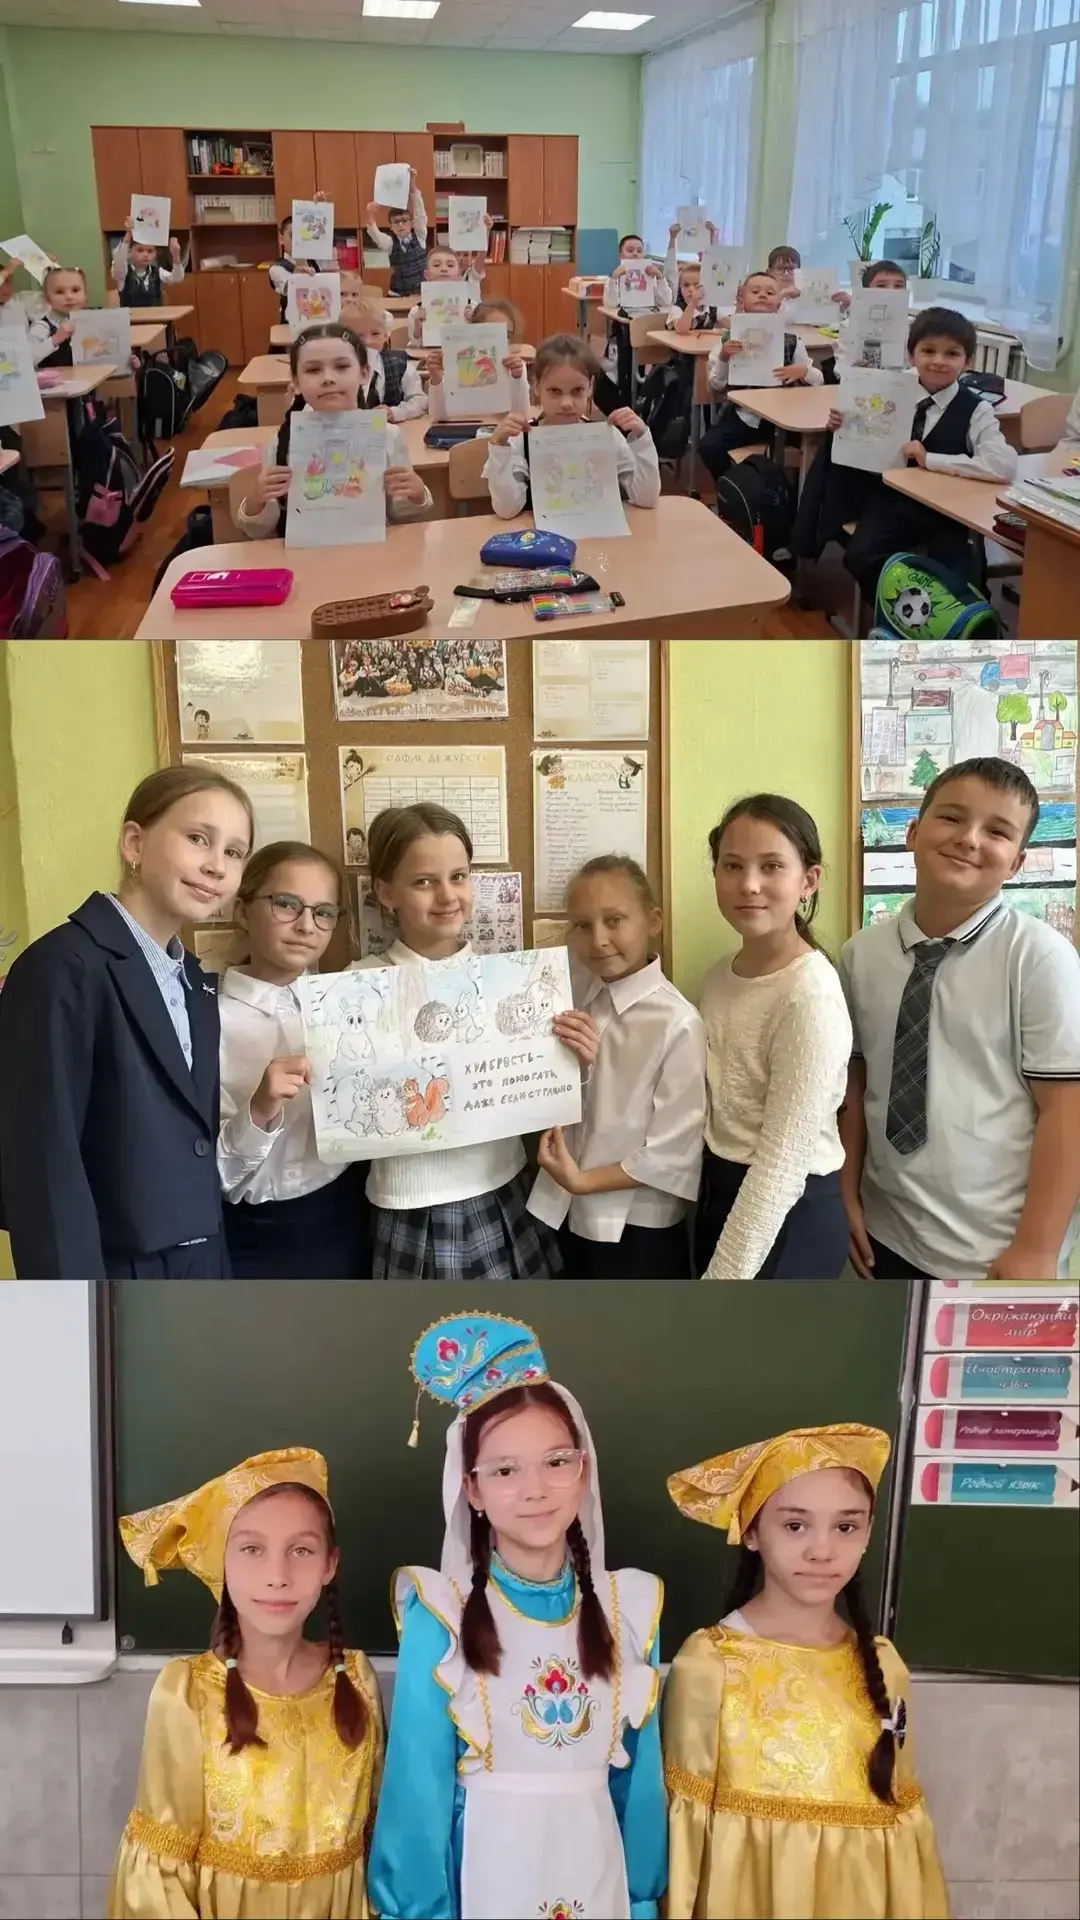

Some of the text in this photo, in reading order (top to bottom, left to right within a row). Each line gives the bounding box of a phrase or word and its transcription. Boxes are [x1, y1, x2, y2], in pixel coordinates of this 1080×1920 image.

[379, 752, 424, 763] ГРАФИК
[565, 759, 613, 770] СПИСОК
[567, 772, 616, 782] КЛАССА
[472, 1079, 493, 1090] ЭТО
[463, 1097, 495, 1112] ДАЖЕ
[971, 1308, 1073, 1323] Окружающий
[1004, 1328, 1037, 1339] мир
[965, 1363, 1066, 1376] Иностранный
[999, 1380, 1030, 1389] язык
[960, 1426, 1056, 1438] Родная литература
[960, 1477, 1041, 1490] Родной язык
